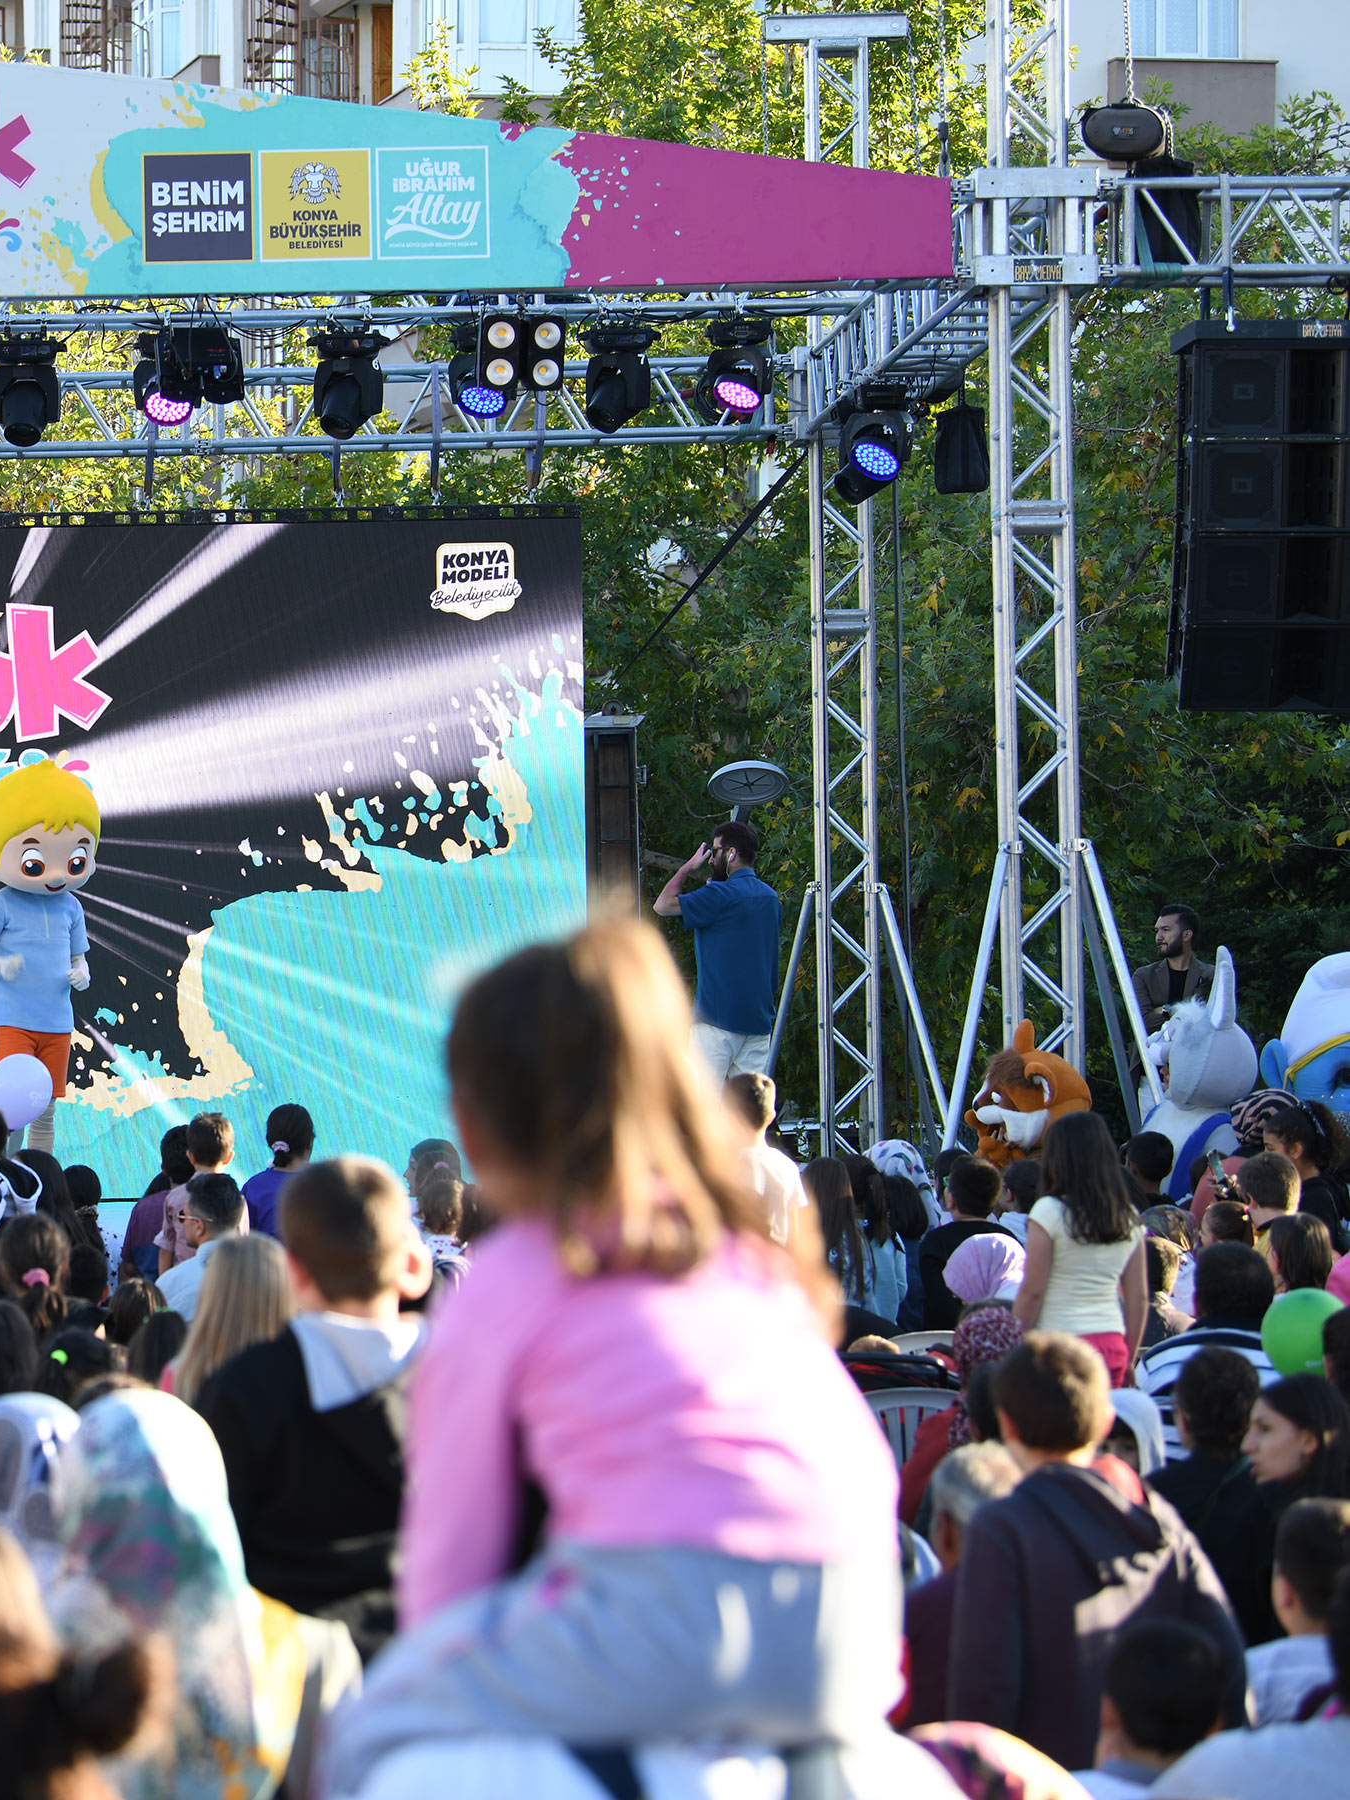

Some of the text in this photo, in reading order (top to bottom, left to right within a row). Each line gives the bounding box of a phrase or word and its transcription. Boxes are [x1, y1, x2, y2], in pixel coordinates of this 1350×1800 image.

[405, 158, 461, 178] UĞUR
[292, 209, 338, 222] KONYA
[385, 193, 482, 240] Altay
[269, 221, 362, 240] BÜYÜKŞEHİR
[289, 238, 343, 249] BELEDİYESİ
[442, 549, 509, 569] KONYA
[431, 581, 520, 609] Belediyecilik
